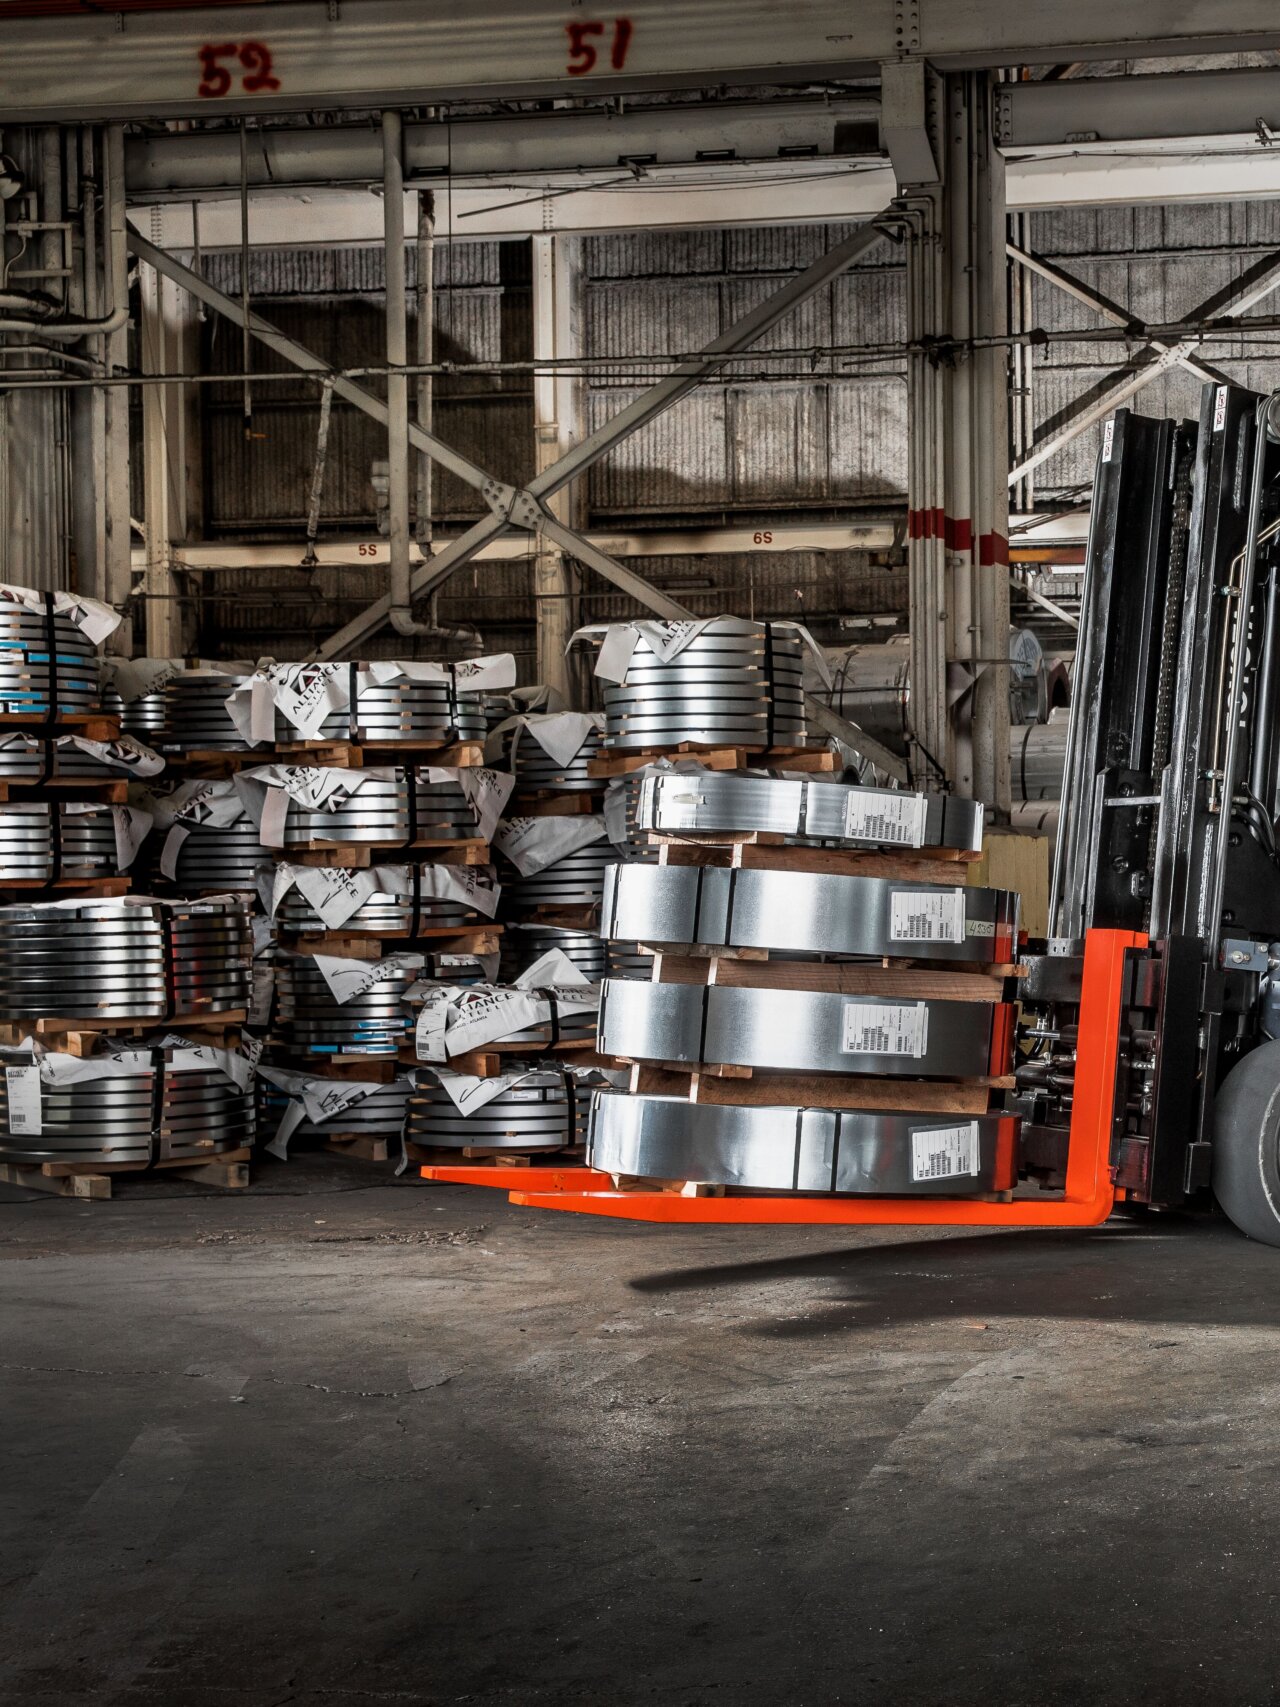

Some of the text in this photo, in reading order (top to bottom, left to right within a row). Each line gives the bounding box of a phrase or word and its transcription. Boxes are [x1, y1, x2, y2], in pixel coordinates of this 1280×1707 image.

[198, 42, 280, 98] 52
[566, 19, 632, 75] 51
[358, 544, 377, 556] 5S
[753, 531, 773, 544] 6S
[292, 663, 342, 715] ALLIANCE
